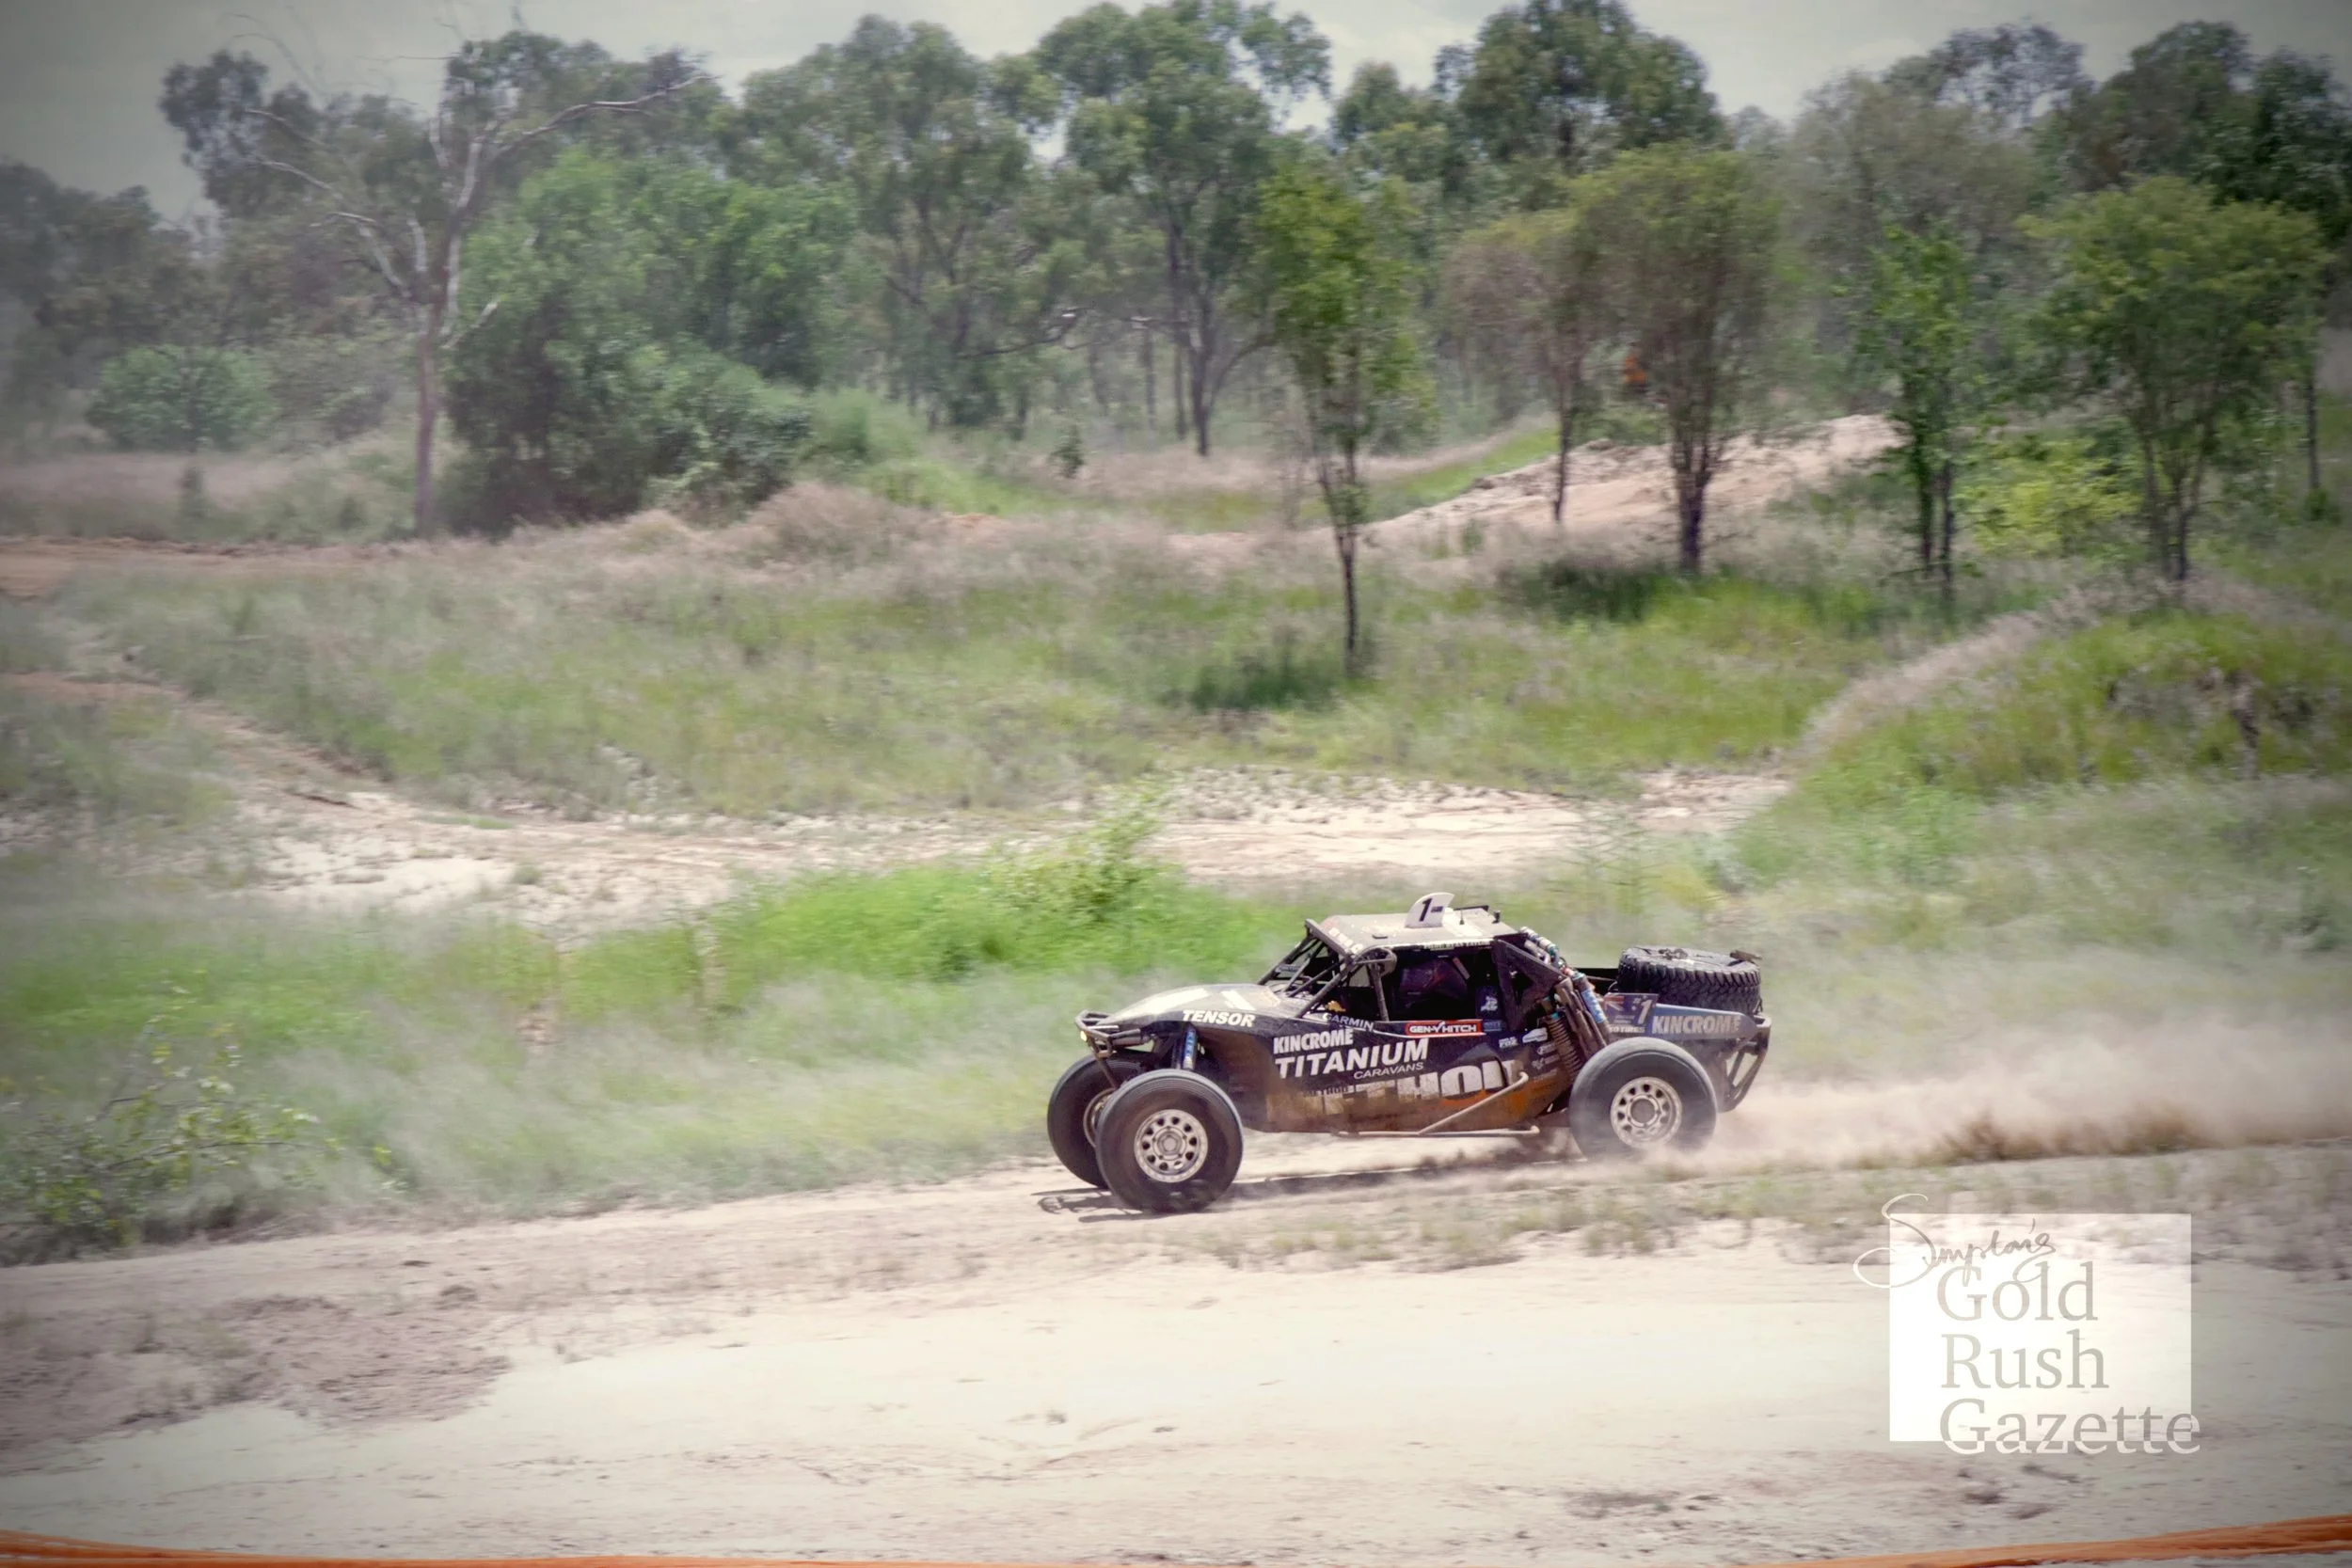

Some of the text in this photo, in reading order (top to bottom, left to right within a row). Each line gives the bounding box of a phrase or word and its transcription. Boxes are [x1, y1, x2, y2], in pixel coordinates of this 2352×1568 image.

[1419, 897, 1433, 923] 1
[1183, 1009, 1256, 1028] TENSOR
[1322, 1012, 1375, 1032] GARMIN
[1273, 1028, 1355, 1054] KINCROME
[1274, 1037, 1430, 1080] TITANIUM
[1353, 1062, 1425, 1080] CARAVANS
